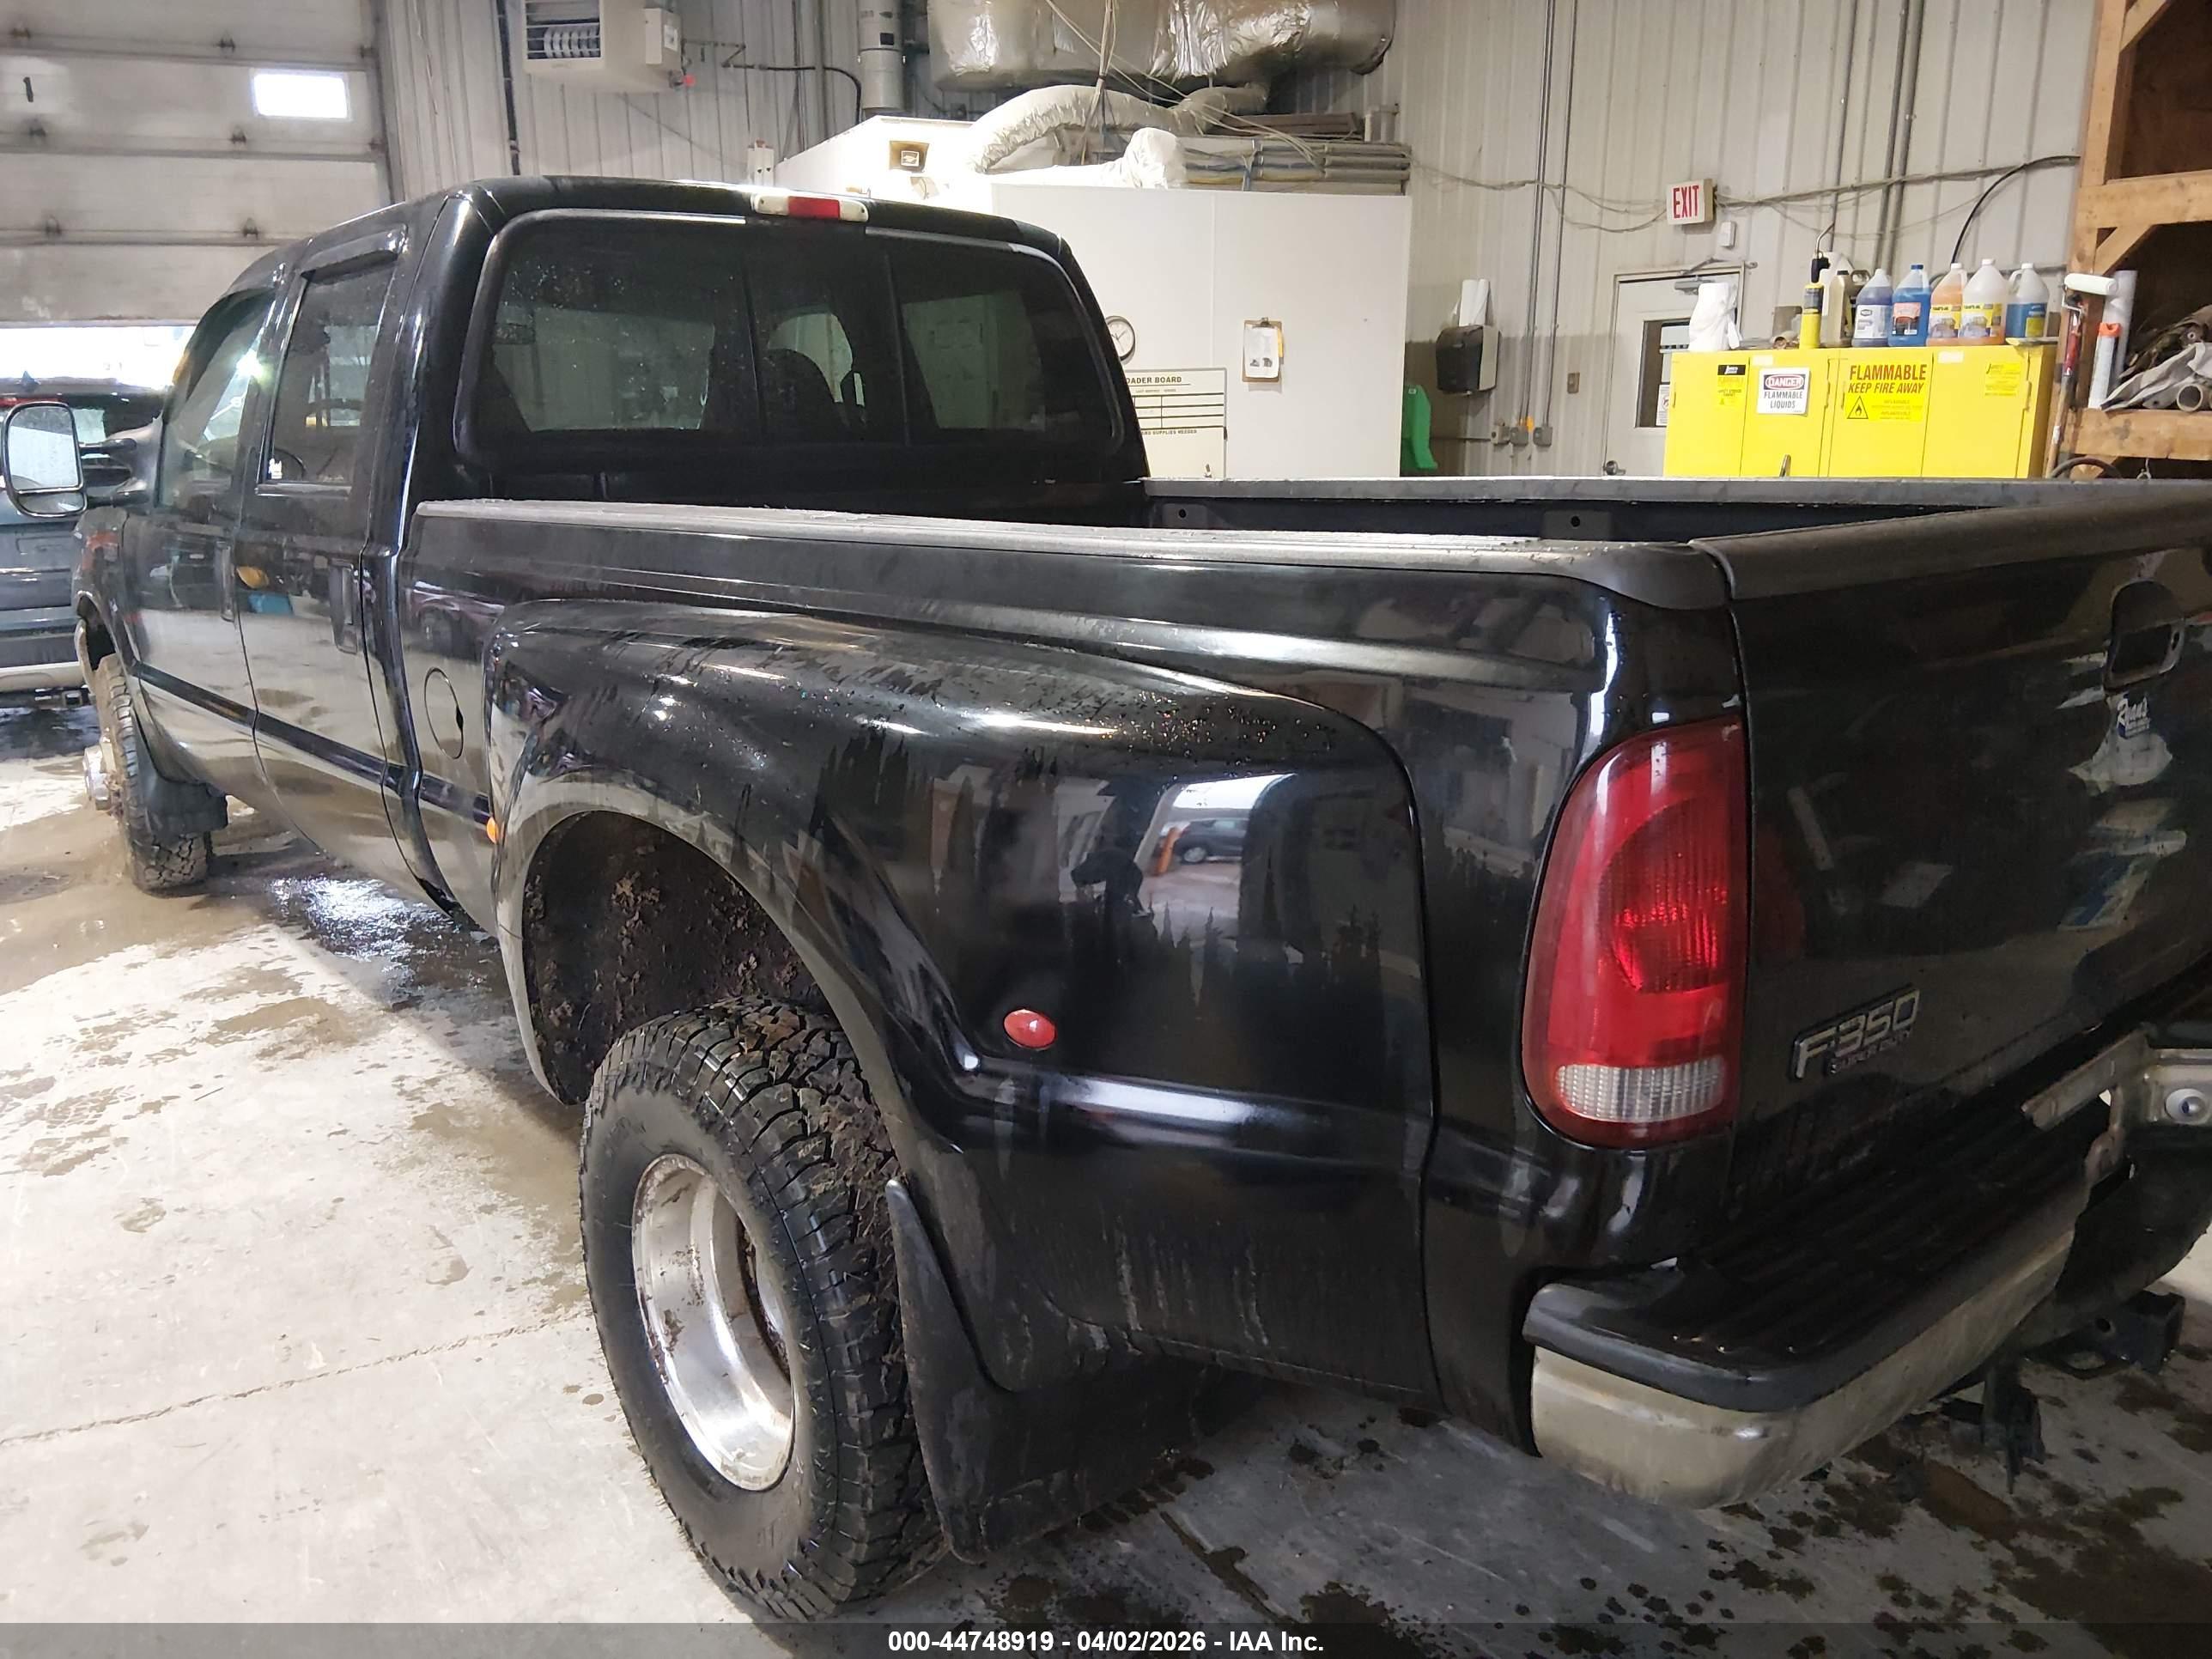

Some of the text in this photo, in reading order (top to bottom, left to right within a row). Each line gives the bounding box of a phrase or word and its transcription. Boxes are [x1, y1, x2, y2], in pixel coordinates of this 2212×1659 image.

[1673, 185, 1699, 218] EXIT
[1850, 364, 1928, 380] FLAMMABLE
[1769, 377, 1802, 386] DANGER
[1848, 382, 1924, 393] KEEP FIRE AWAY
[1764, 391, 1803, 399] FLAMMABLE
[1770, 400, 1796, 409] LIQUIDS
